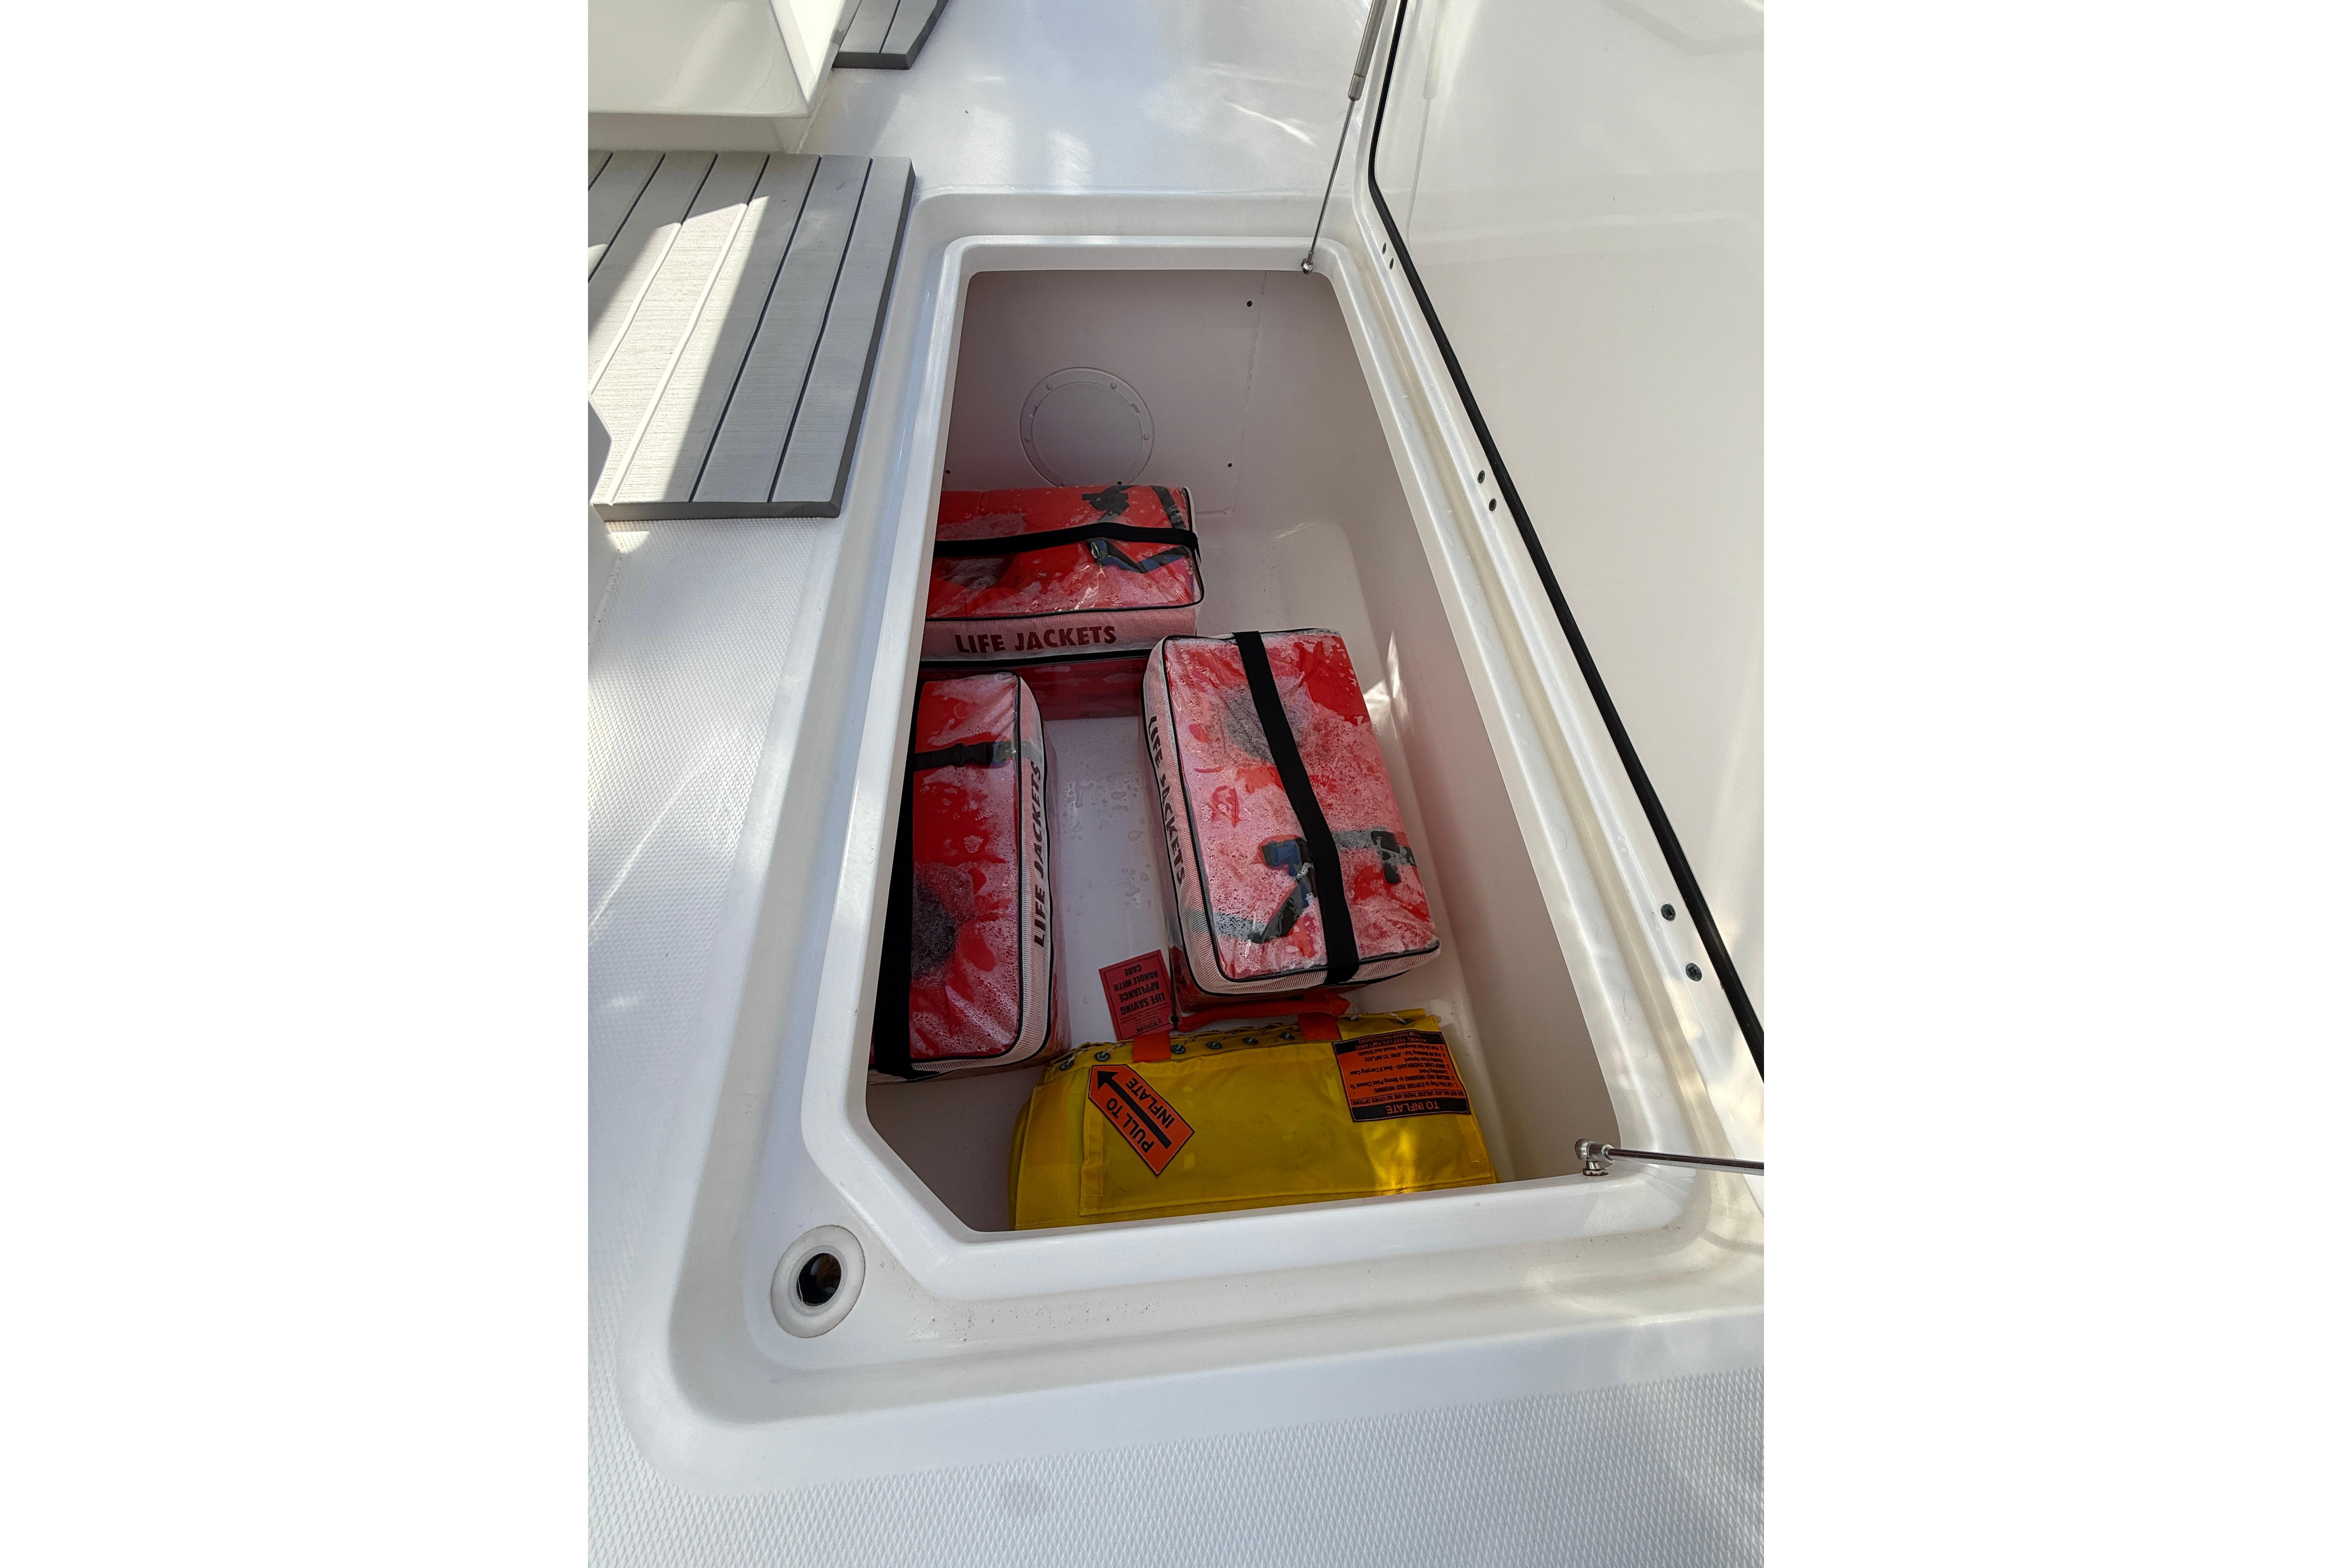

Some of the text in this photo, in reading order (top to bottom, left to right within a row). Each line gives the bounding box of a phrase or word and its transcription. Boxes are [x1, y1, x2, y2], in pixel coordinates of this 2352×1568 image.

[955, 625, 1117, 653] LIFE JACKETS
[1148, 716, 1185, 885] LIFE JACKETS
[1031, 760, 1046, 948] LIFE JACKETS
[1113, 970, 1158, 992] HANDLE WITH
[1124, 964, 1142, 976] CARE
[1118, 981, 1159, 1002] APPLIANCE
[1150, 992, 1165, 1004] LIFE
[1120, 998, 1149, 1015] SAVING
[1125, 1077, 1175, 1129] INFLATE
[1385, 1100, 1440, 1114] TO INFLATE
[1106, 1098, 1155, 1153] PULL TO
